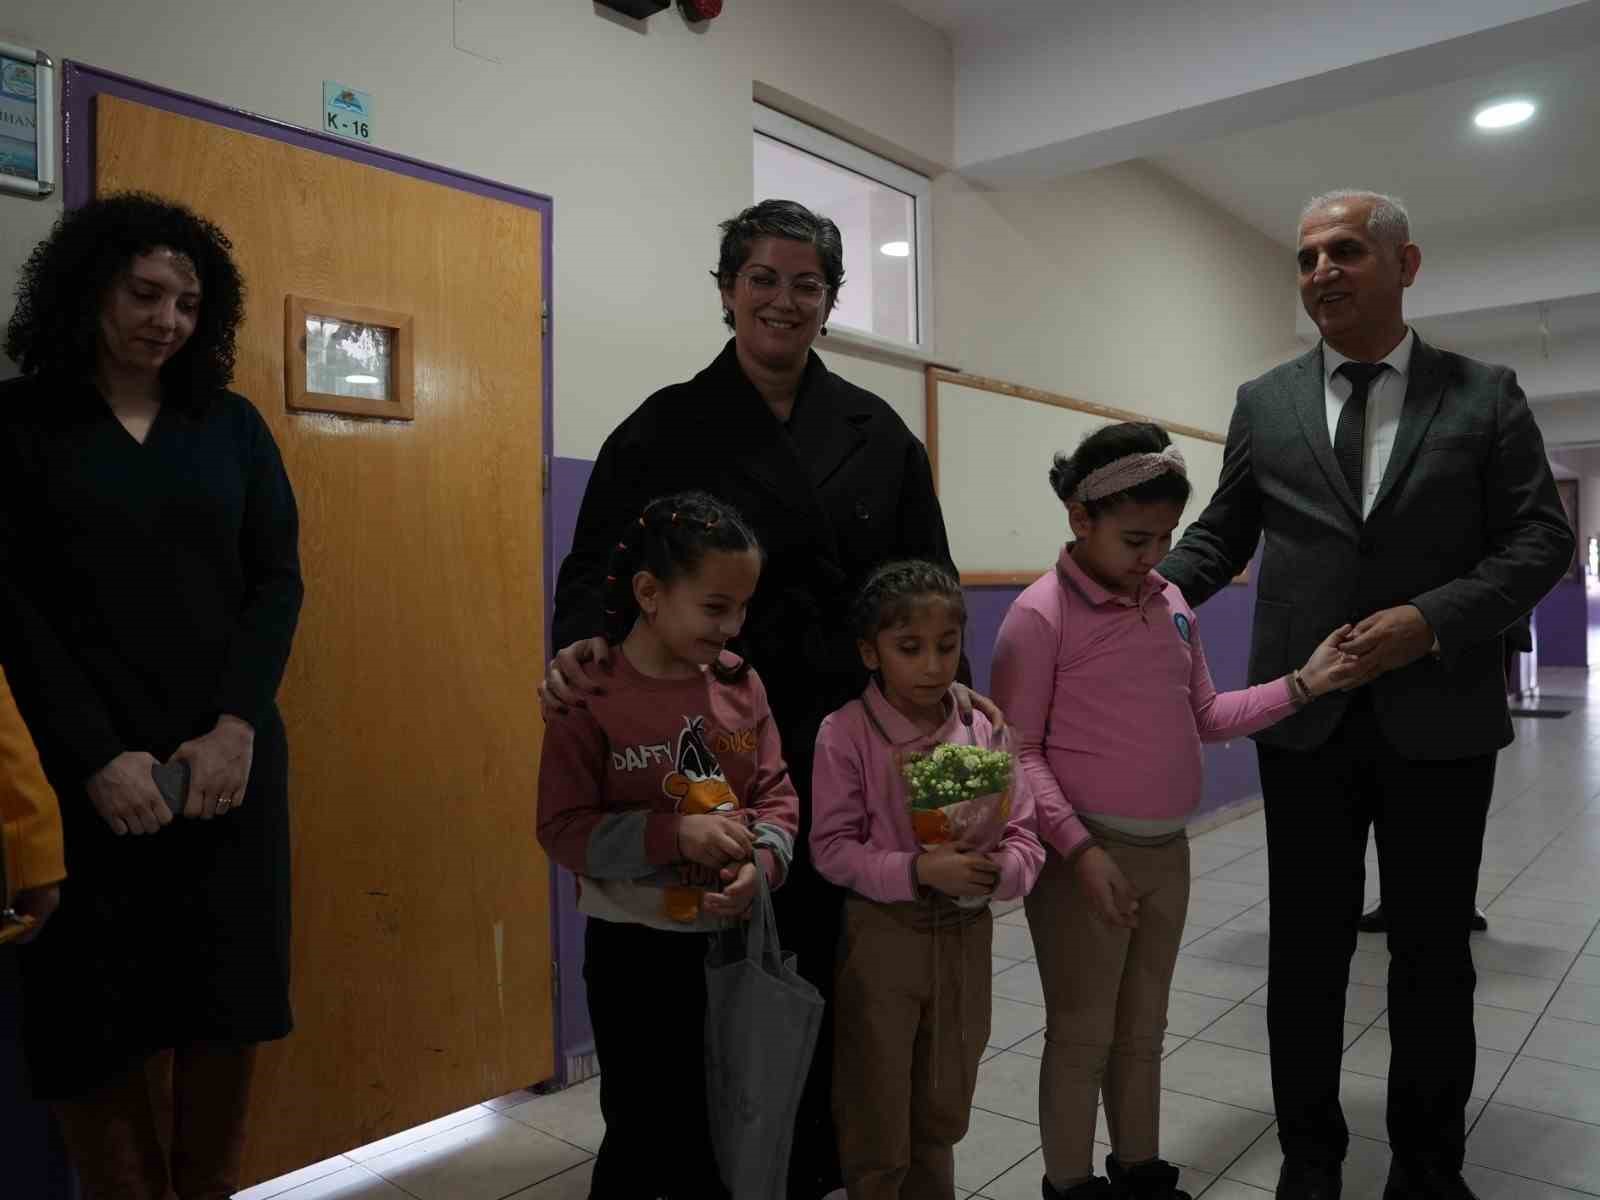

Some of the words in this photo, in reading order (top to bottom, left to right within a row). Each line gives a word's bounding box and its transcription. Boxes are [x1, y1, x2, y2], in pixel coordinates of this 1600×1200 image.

[327, 112, 338, 129] K
[352, 120, 369, 138] 16
[712, 729, 757, 753] DUC
[610, 737, 674, 772] DAFFY
